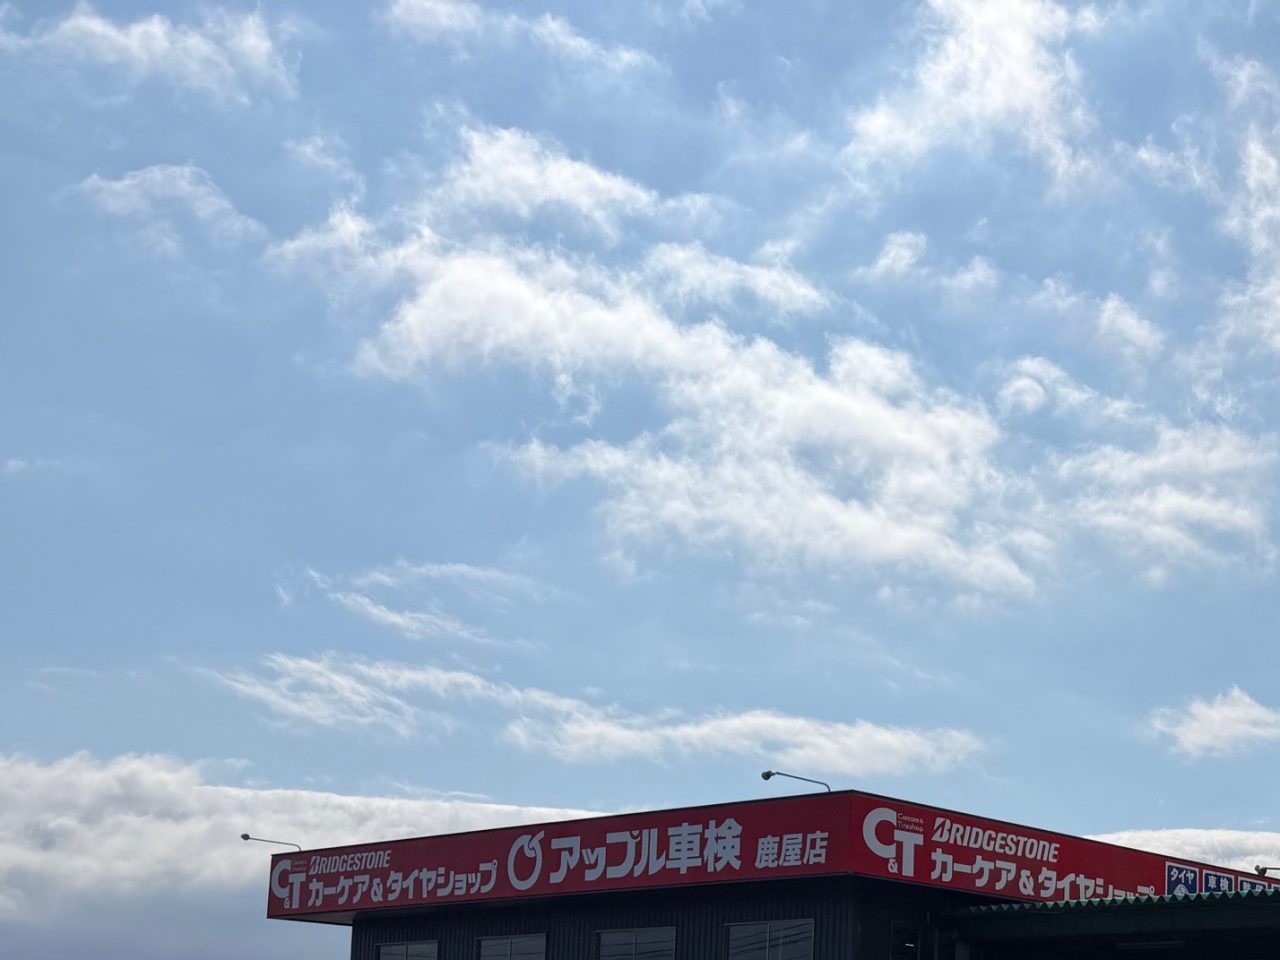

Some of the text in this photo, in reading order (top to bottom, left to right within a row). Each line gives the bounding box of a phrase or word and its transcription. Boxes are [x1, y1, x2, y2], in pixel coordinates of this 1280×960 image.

[550, 817, 829, 885] アップル車検 鹿屋店
[931, 817, 1060, 863] BRIDGESTONE
[309, 850, 392, 875] BRIDGESTONE
[1170, 868, 1195, 885] タイヤ
[1208, 875, 1230, 891] 車検
